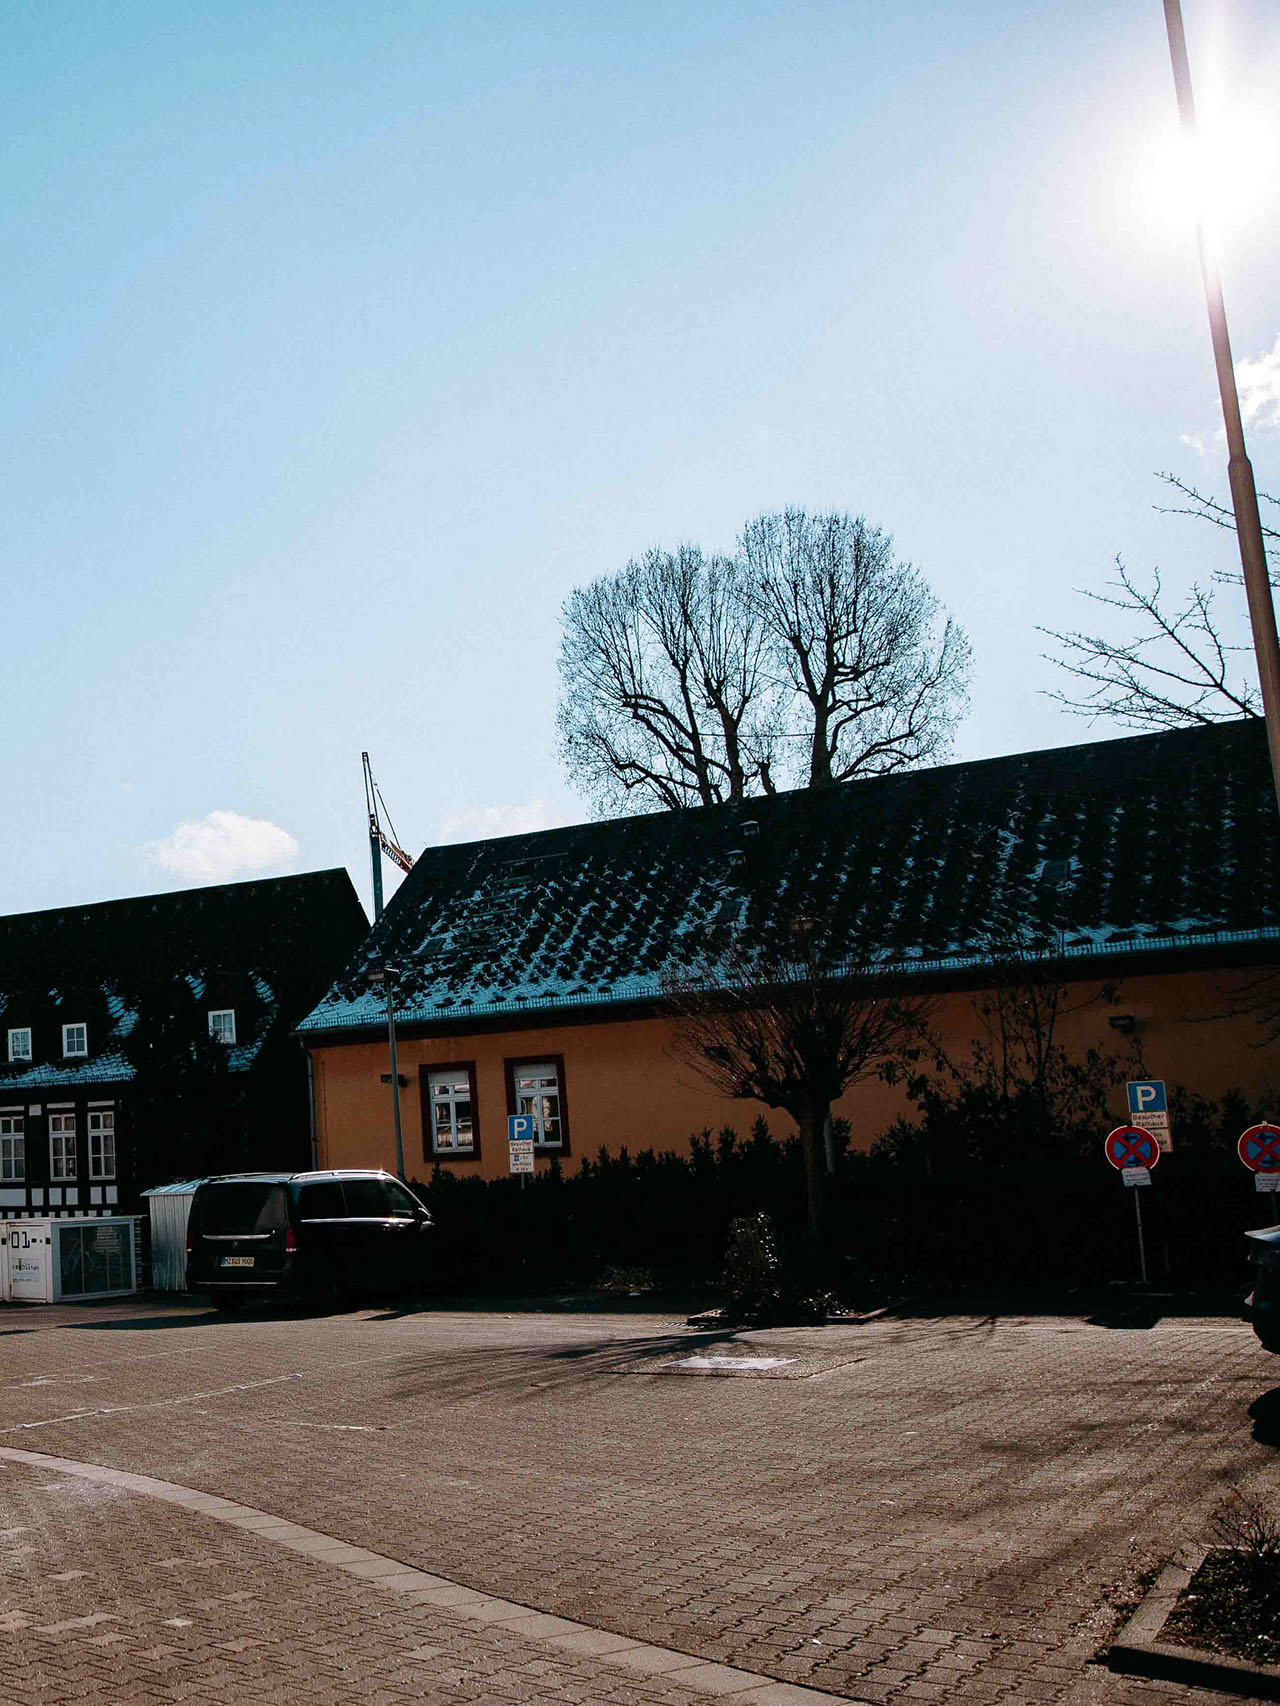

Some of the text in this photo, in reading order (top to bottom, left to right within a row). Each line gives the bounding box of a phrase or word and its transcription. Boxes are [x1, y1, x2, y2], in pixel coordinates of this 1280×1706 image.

[1136, 1085, 1157, 1111] P
[513, 1118, 528, 1139] P
[11, 1231, 30, 1249] 01
